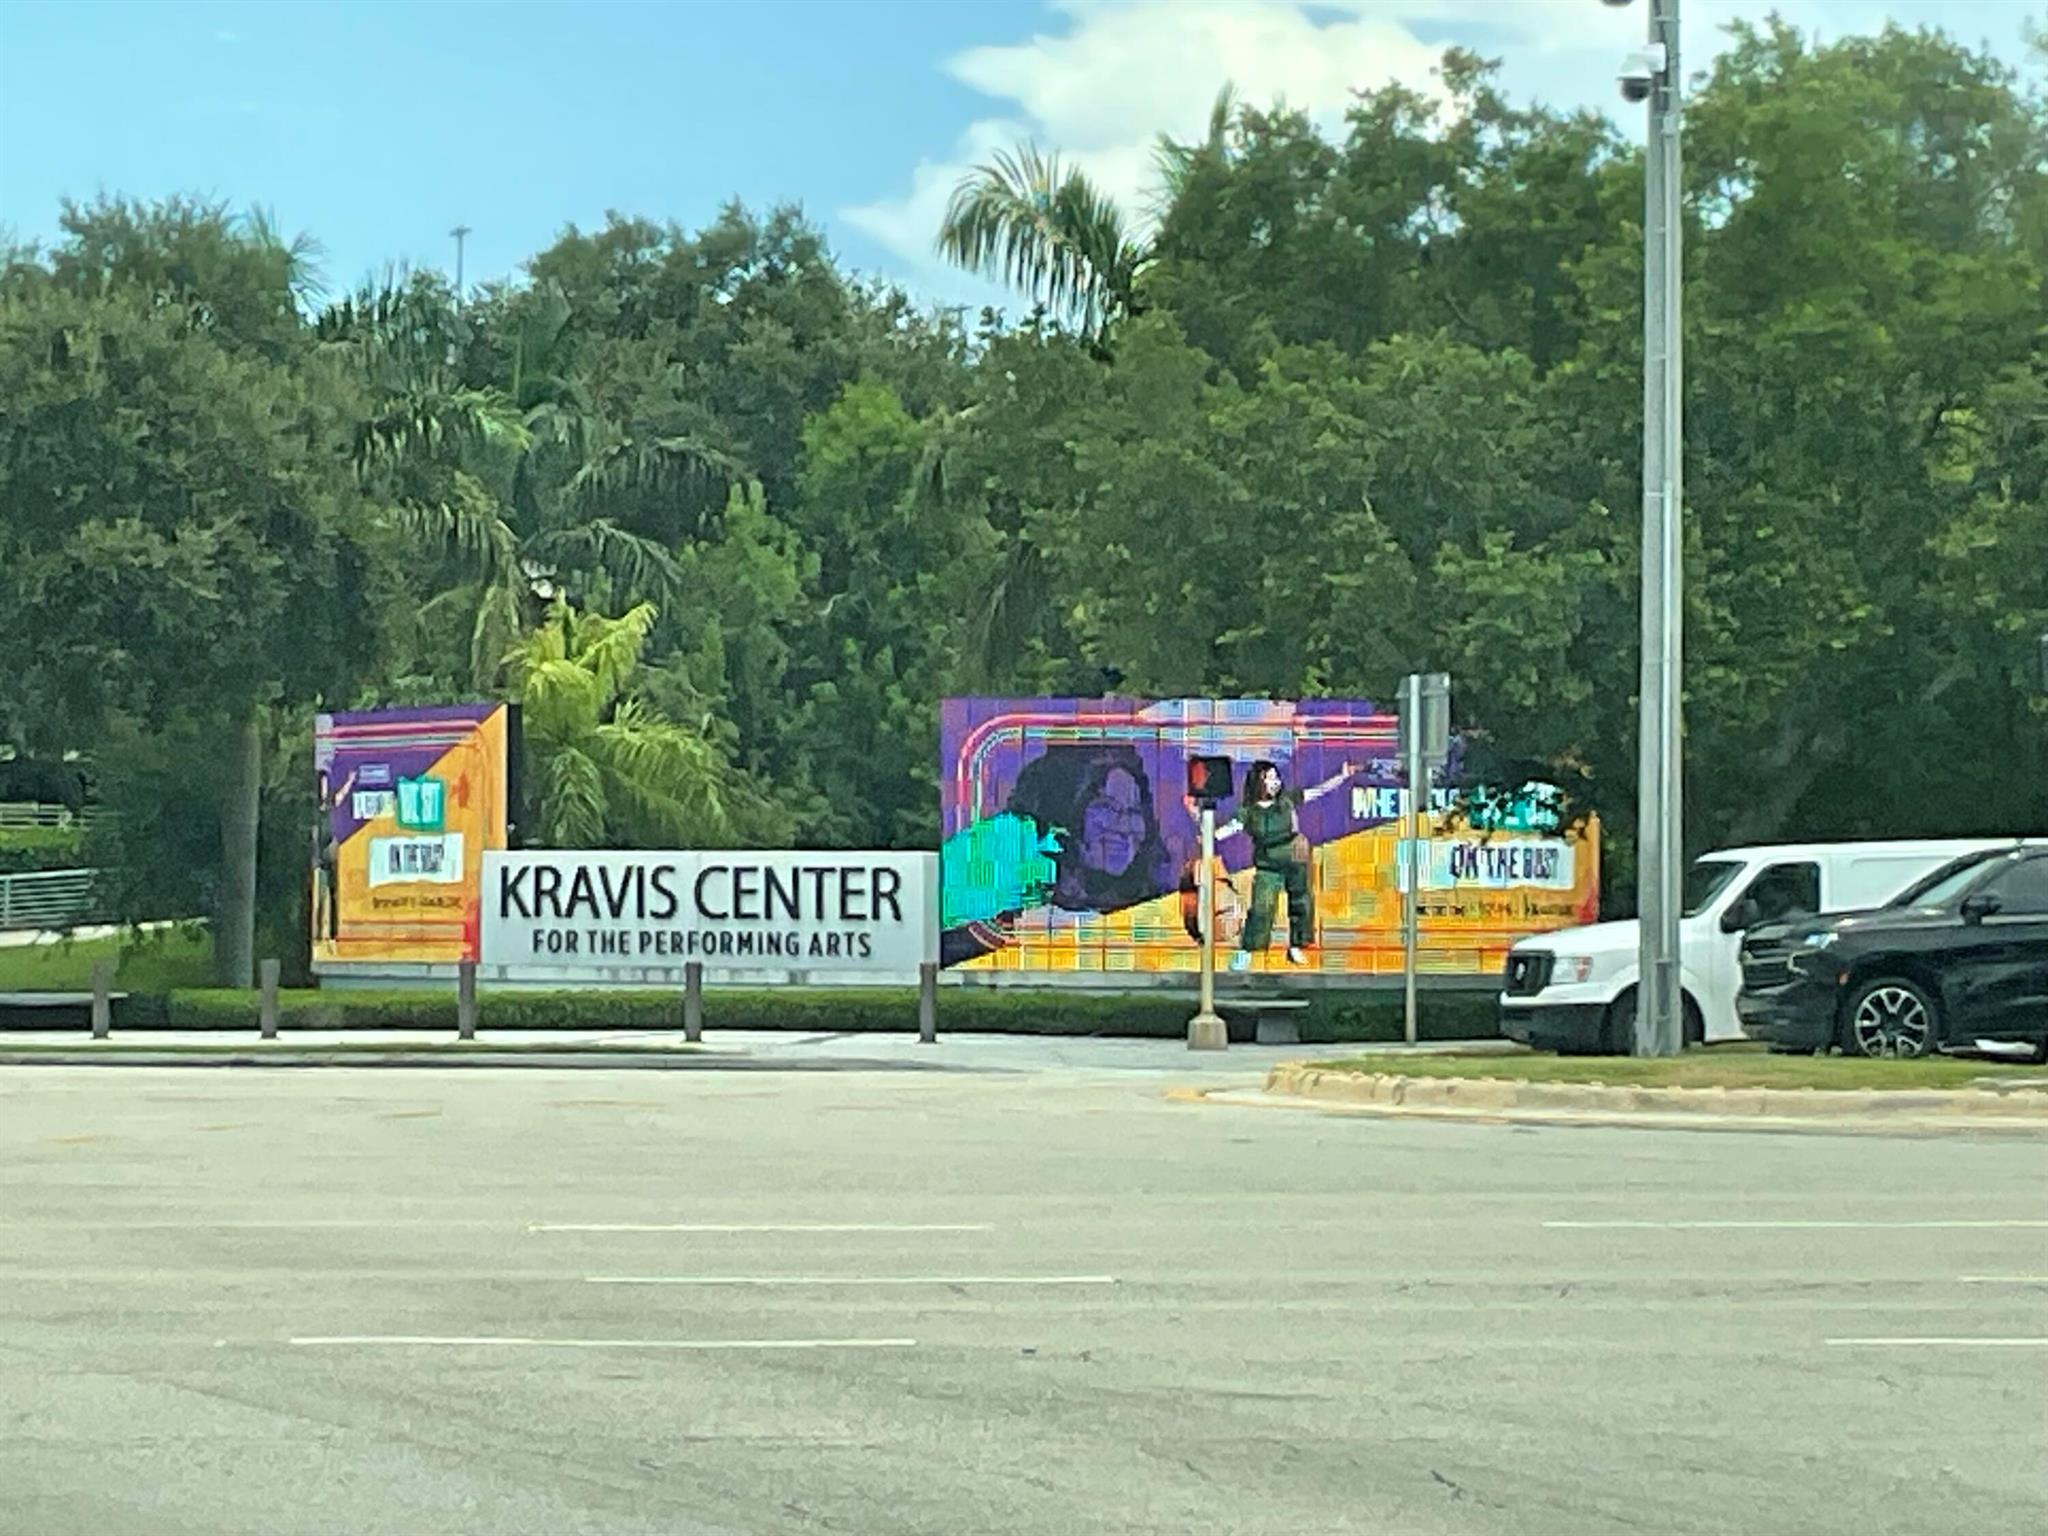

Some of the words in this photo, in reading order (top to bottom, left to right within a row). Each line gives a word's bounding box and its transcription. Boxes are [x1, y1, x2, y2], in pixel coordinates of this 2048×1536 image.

[500, 865, 678, 919] KRAVIS
[694, 865, 902, 921] CENTER
[532, 929, 579, 953] FOR
[587, 930, 631, 955] THE
[638, 930, 799, 956] PERFORMING
[808, 932, 872, 957] ARTS
